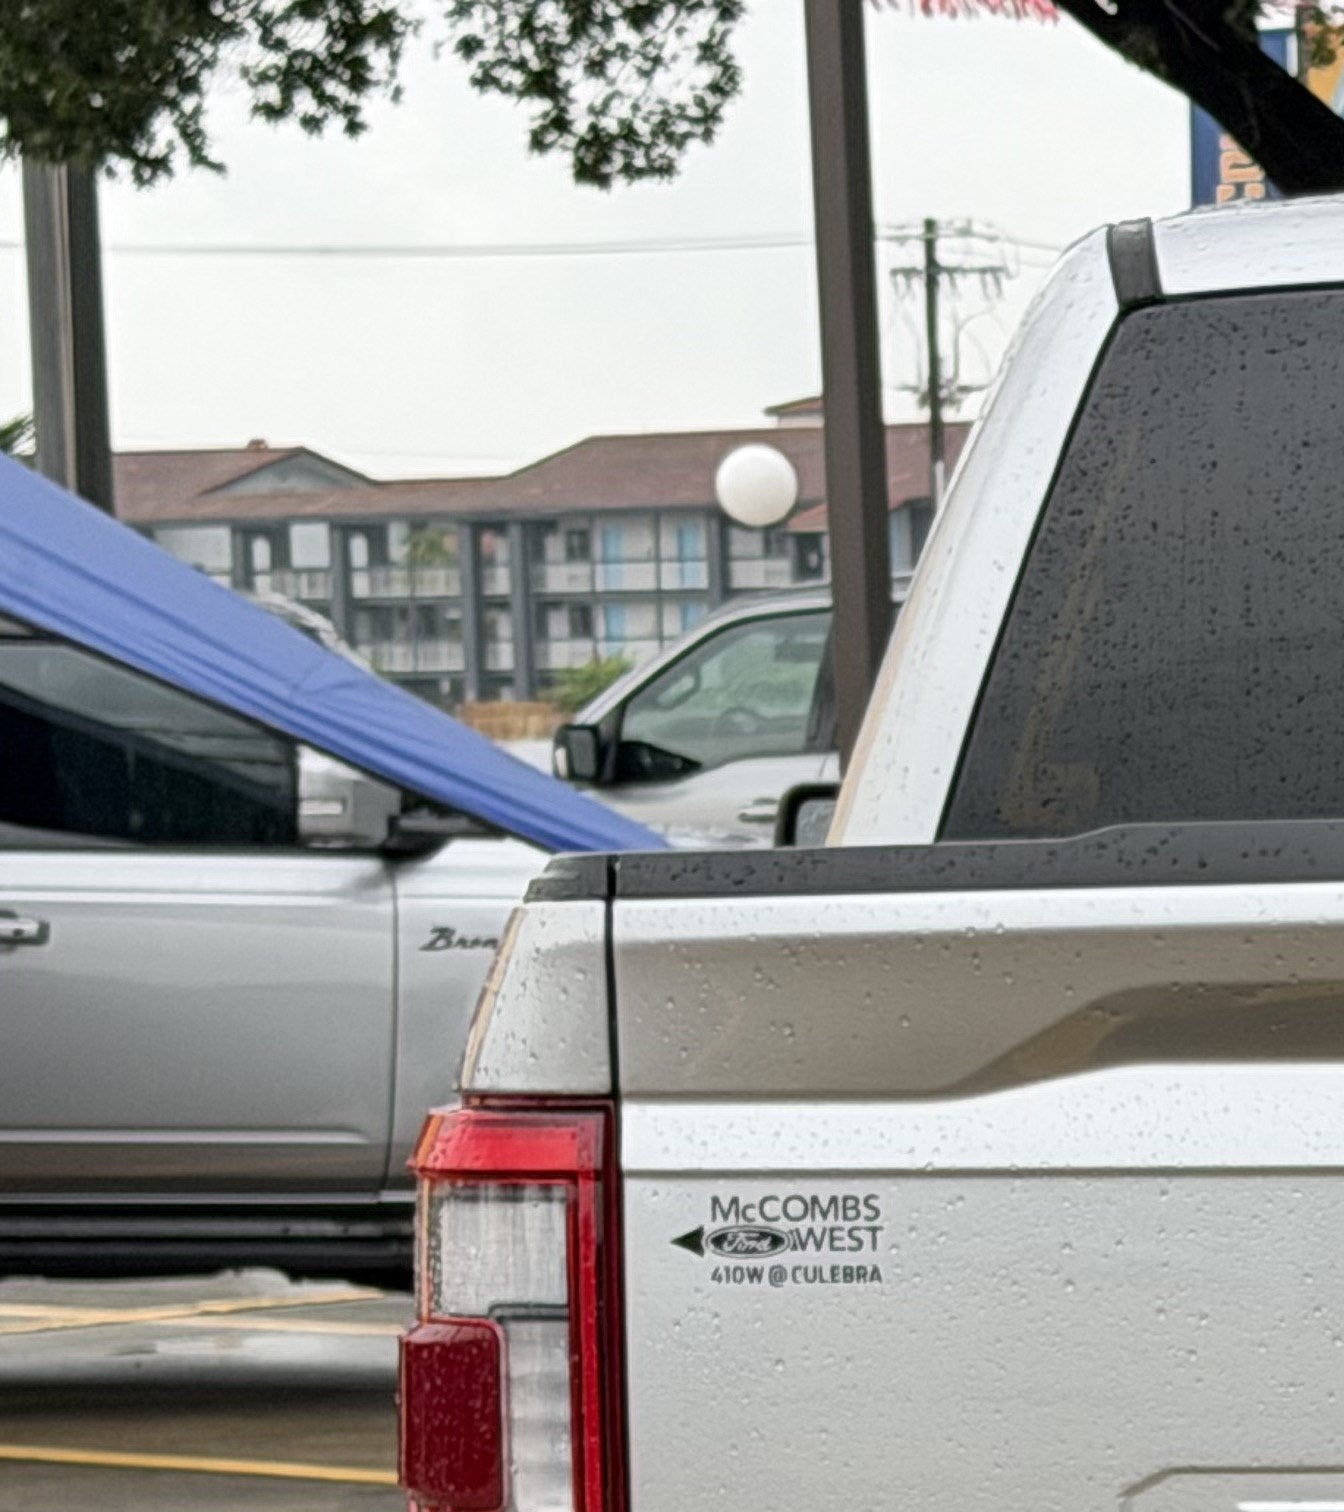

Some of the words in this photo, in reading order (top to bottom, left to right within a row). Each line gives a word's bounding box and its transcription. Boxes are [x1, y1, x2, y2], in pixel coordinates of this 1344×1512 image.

[418, 925, 499, 952] Bron
[710, 1194, 882, 1223] McCOMBS
[794, 1226, 884, 1252] WEST
[710, 1265, 765, 1285] 410W
[768, 1265, 788, 1288] @
[791, 1265, 883, 1285] CULEBRA
